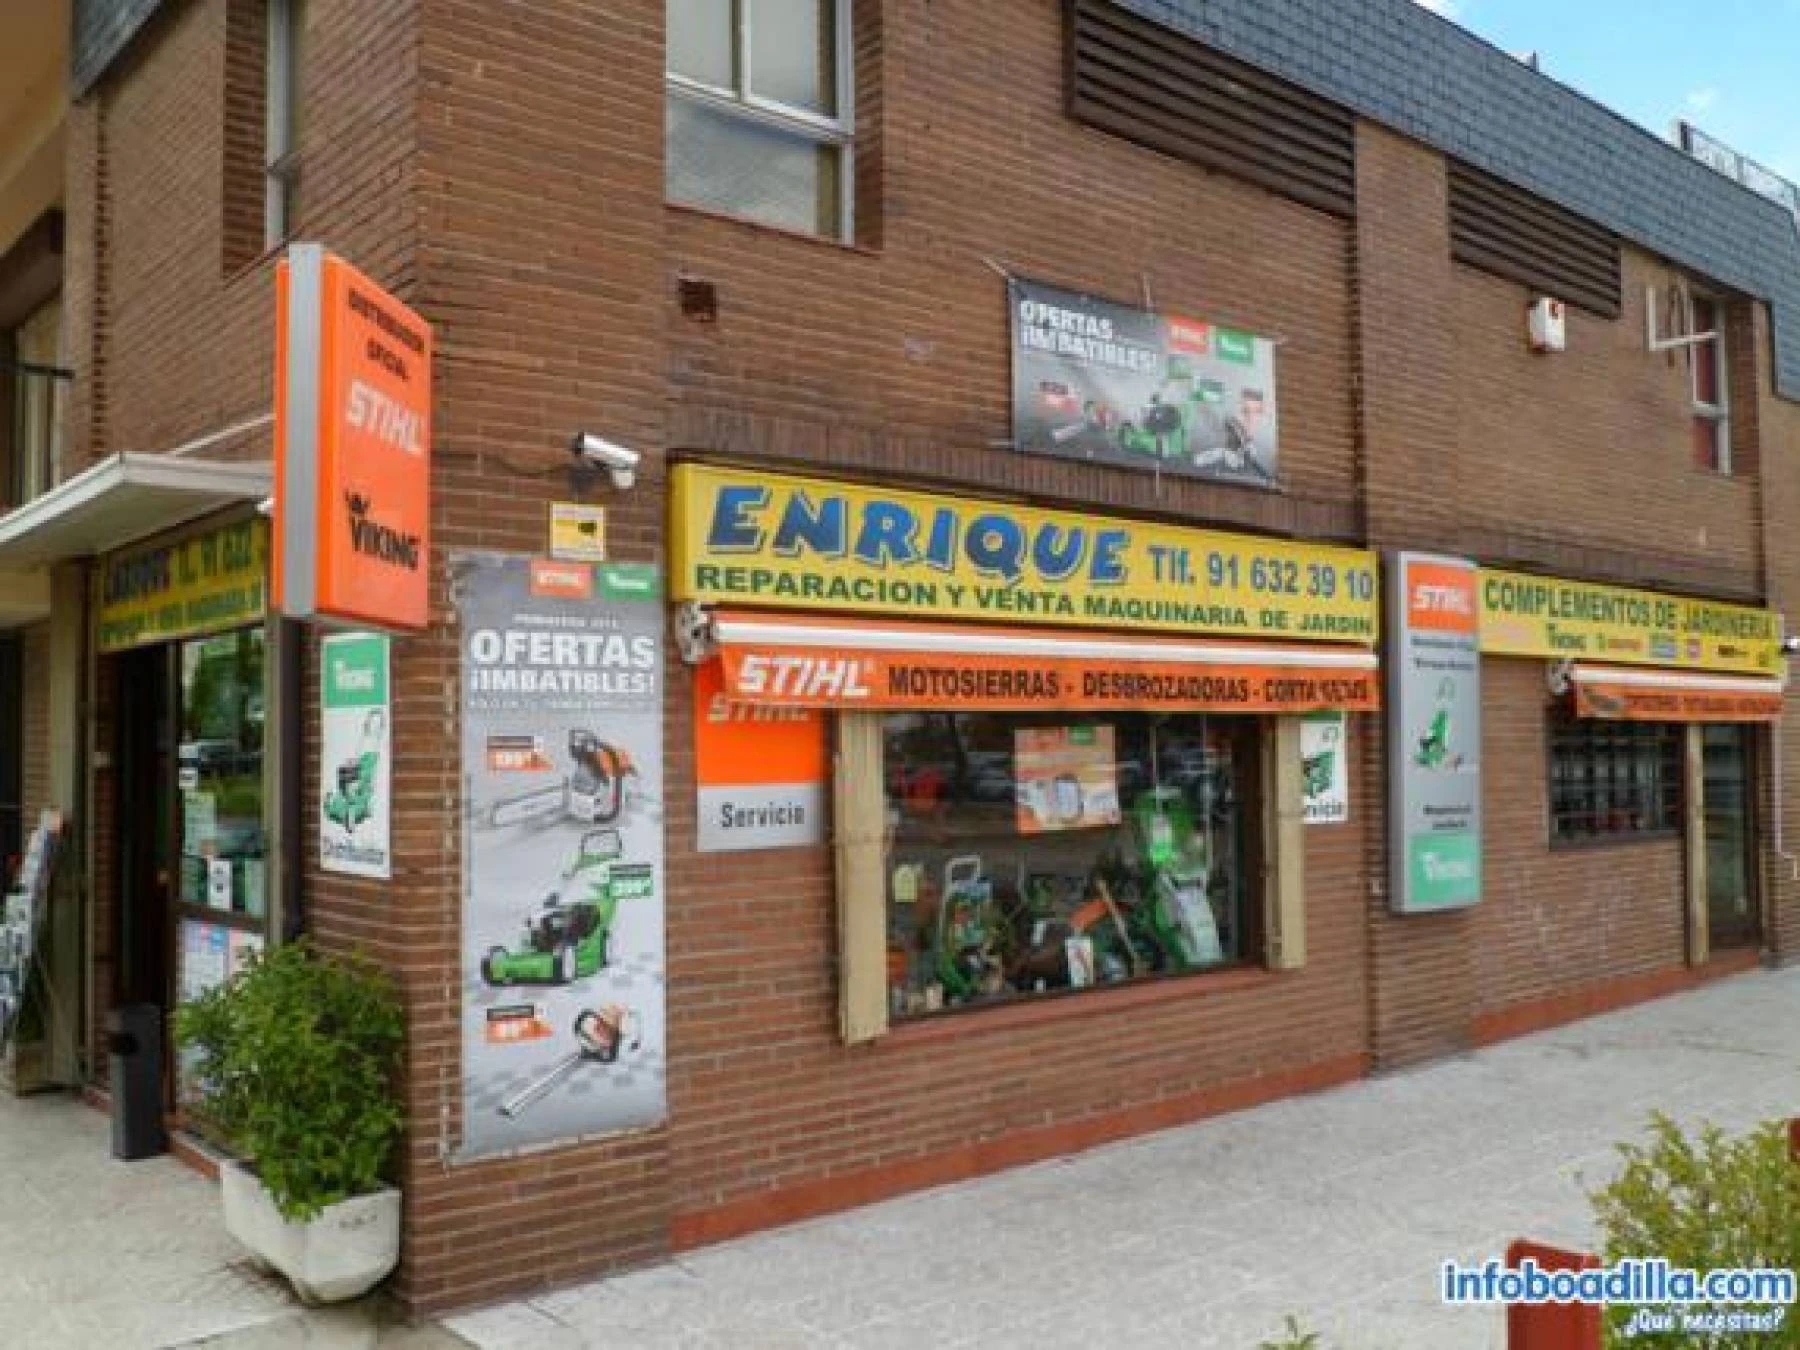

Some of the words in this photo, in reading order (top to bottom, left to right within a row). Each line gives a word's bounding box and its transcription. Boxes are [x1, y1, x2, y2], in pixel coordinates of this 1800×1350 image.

[346, 380, 422, 456] STIHL
[706, 484, 1132, 588] ENRIQUE
[1207, 550, 1239, 589] 91
[1252, 556, 1299, 595] 632
[1307, 564, 1336, 599] 39
[1344, 569, 1374, 602] 10
[696, 563, 937, 606] REPARACION
[945, 584, 965, 606] Y
[973, 587, 1074, 616] VENTA
[1083, 594, 1248, 628] MAQUINARIA
[1259, 610, 1289, 630] DE
[1299, 613, 1373, 635] JARDIN
[1485, 579, 1650, 628] COMPLEMENTOS
[1654, 600, 1676, 630] DE
[470, 629, 655, 668] OFERTAS
[738, 654, 872, 698] STIHL
[888, 663, 1059, 699] MOTOSIERRAS
[1083, 671, 1249, 701] DESBROZADORAS
[721, 801, 805, 829] Servicio
